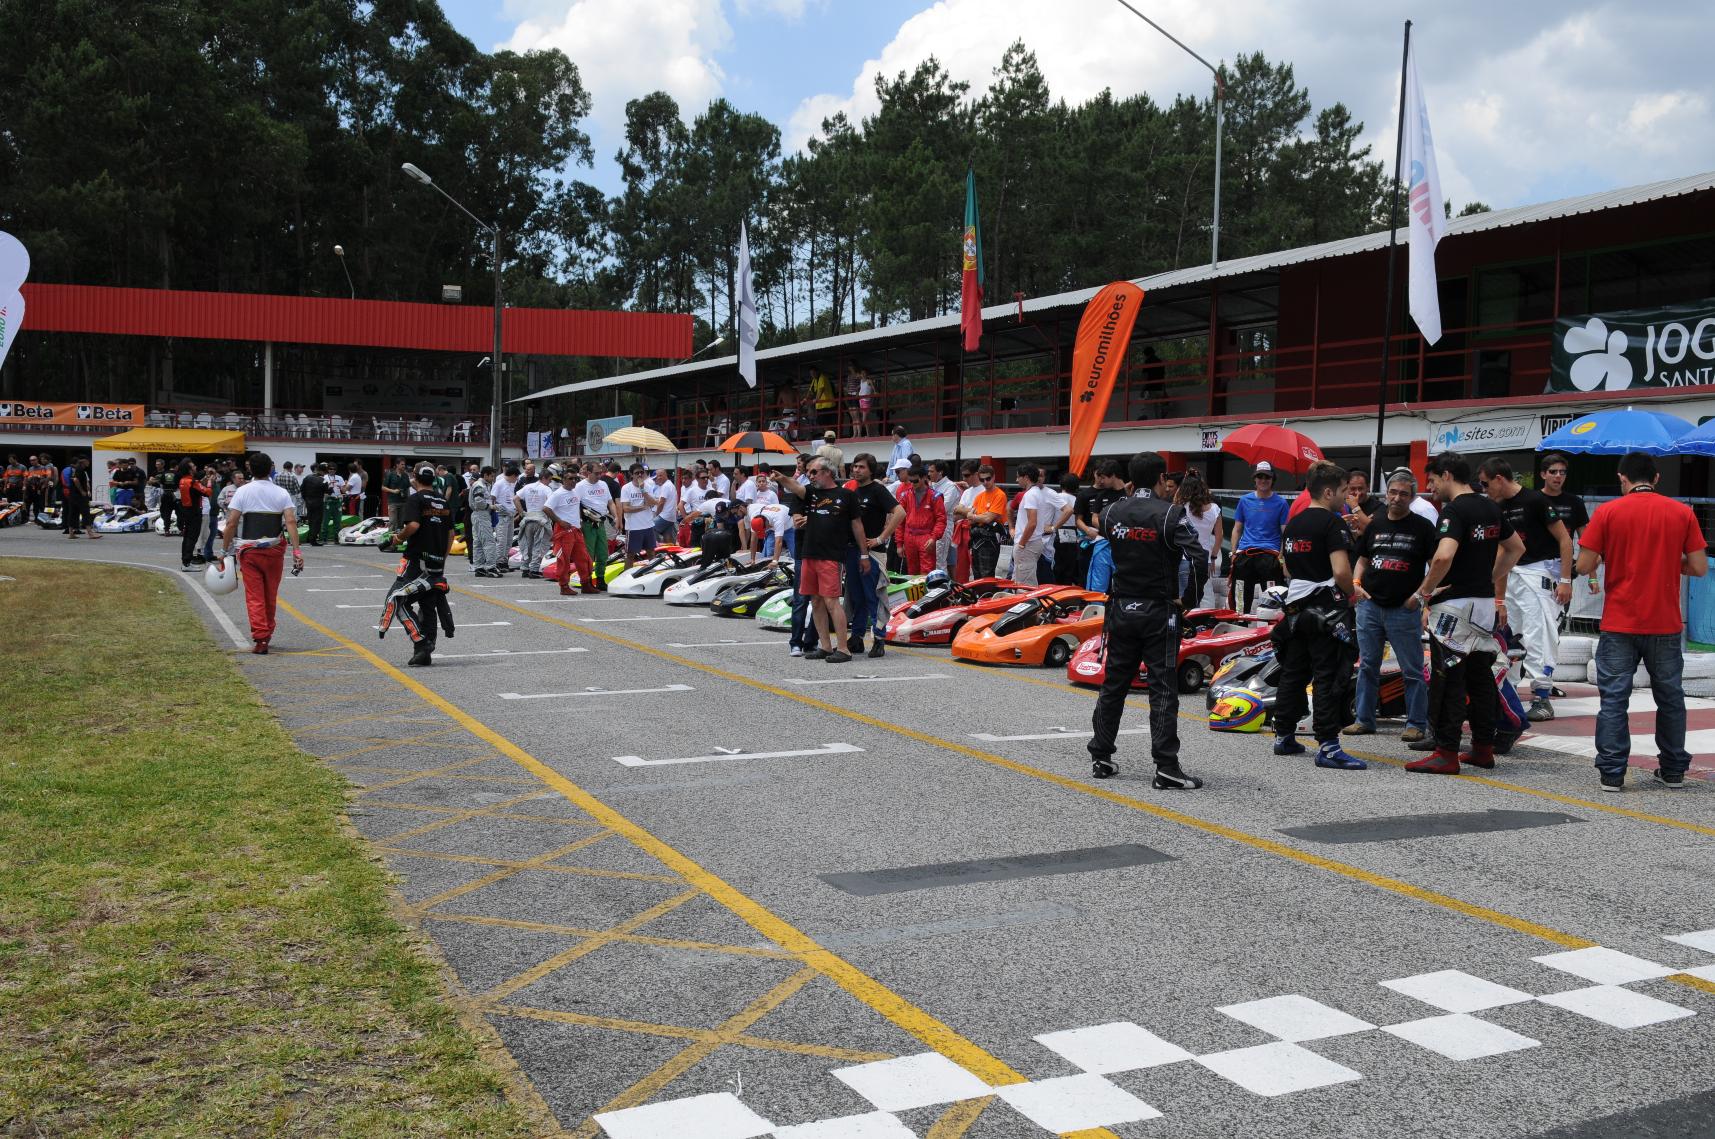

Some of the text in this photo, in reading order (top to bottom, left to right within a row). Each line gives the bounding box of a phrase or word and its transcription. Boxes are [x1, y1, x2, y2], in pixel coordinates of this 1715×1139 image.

[1088, 294, 1126, 389] euromilhões
[1660, 367, 1715, 388] SANT
[13, 403, 54, 418] Beta
[93, 406, 132, 420] Beta
[1115, 526, 1157, 542] RACES
[1374, 558, 1410, 572] RACES
